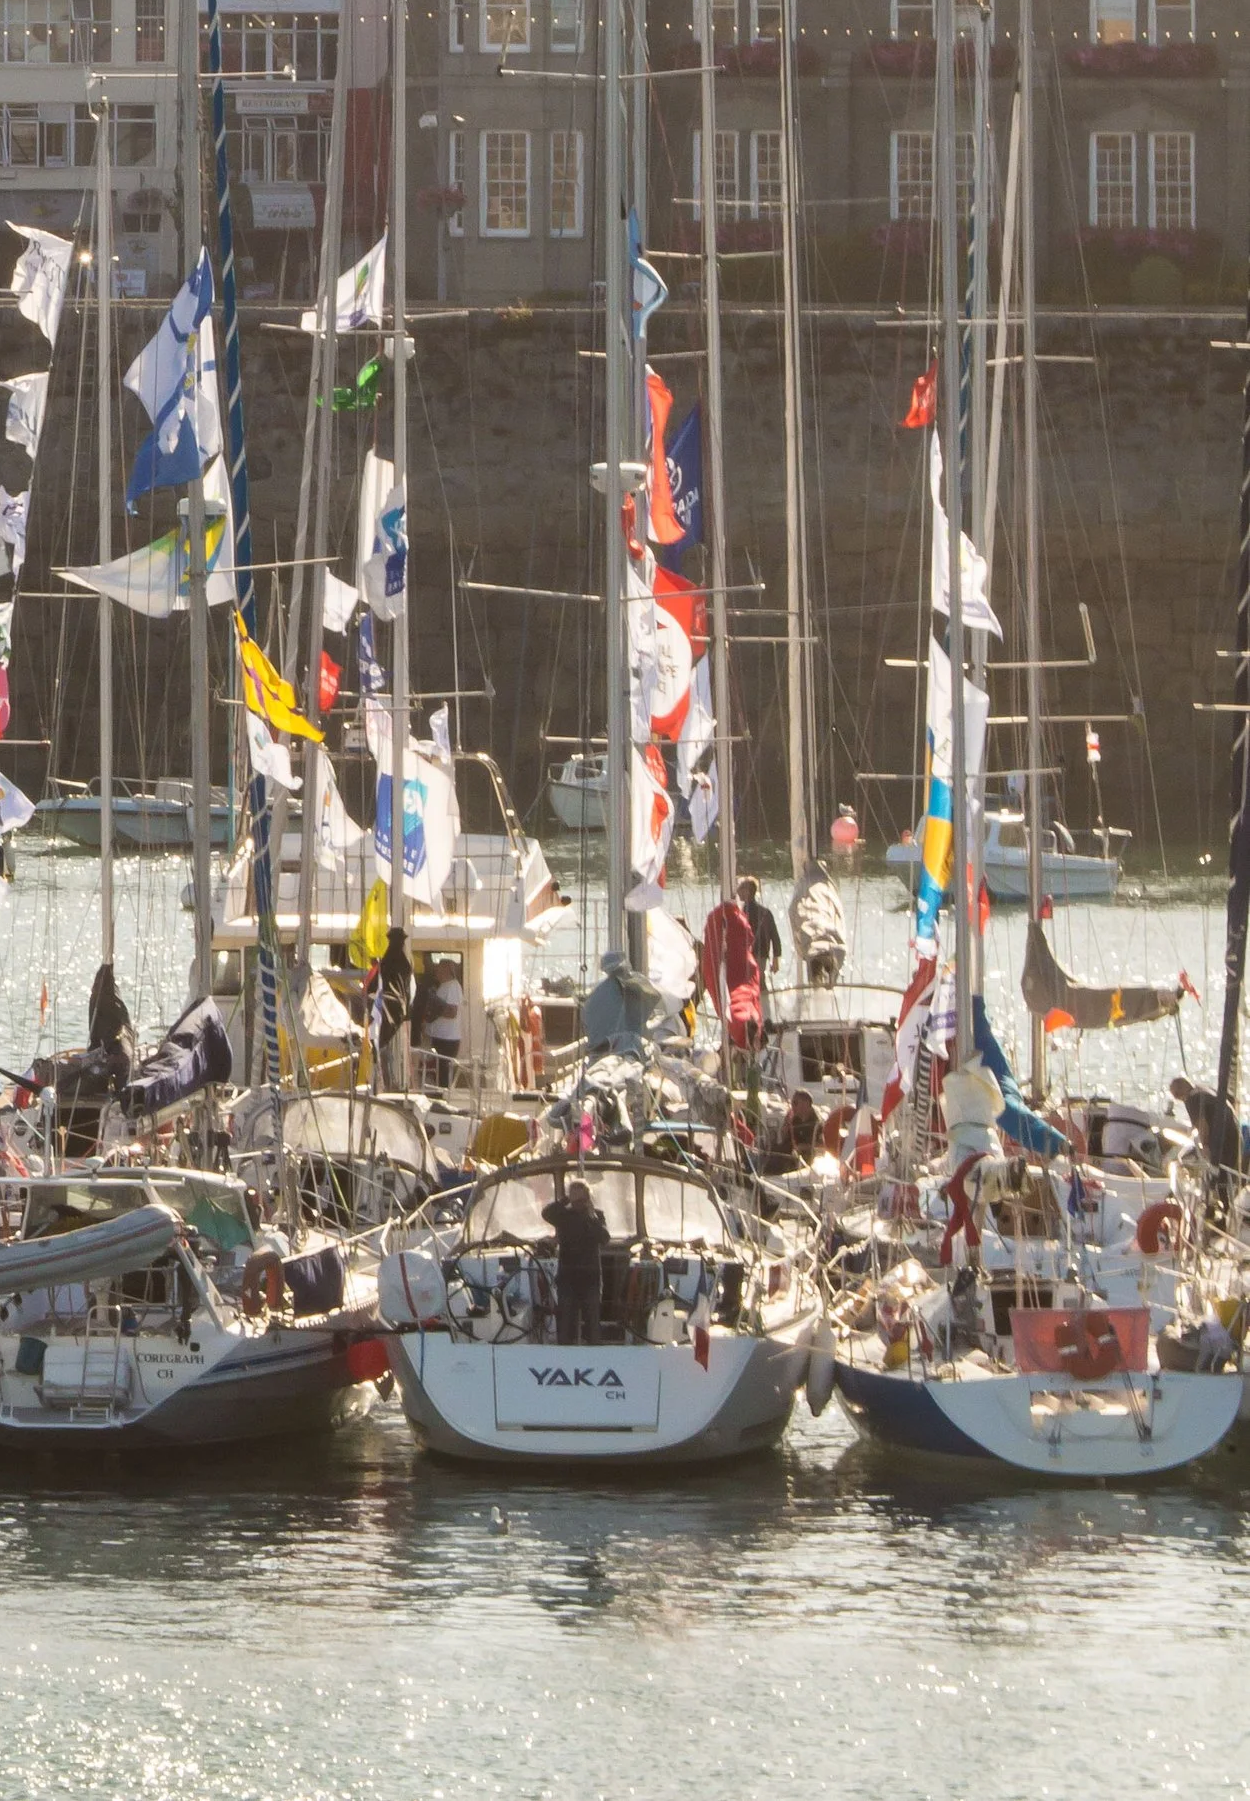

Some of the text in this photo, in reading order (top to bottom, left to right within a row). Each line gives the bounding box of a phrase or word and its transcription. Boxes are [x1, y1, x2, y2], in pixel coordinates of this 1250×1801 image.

[136, 1352, 205, 1365] COREGRAPH
[528, 1367, 625, 1387] YAKA
[605, 1390, 626, 1400] CH
